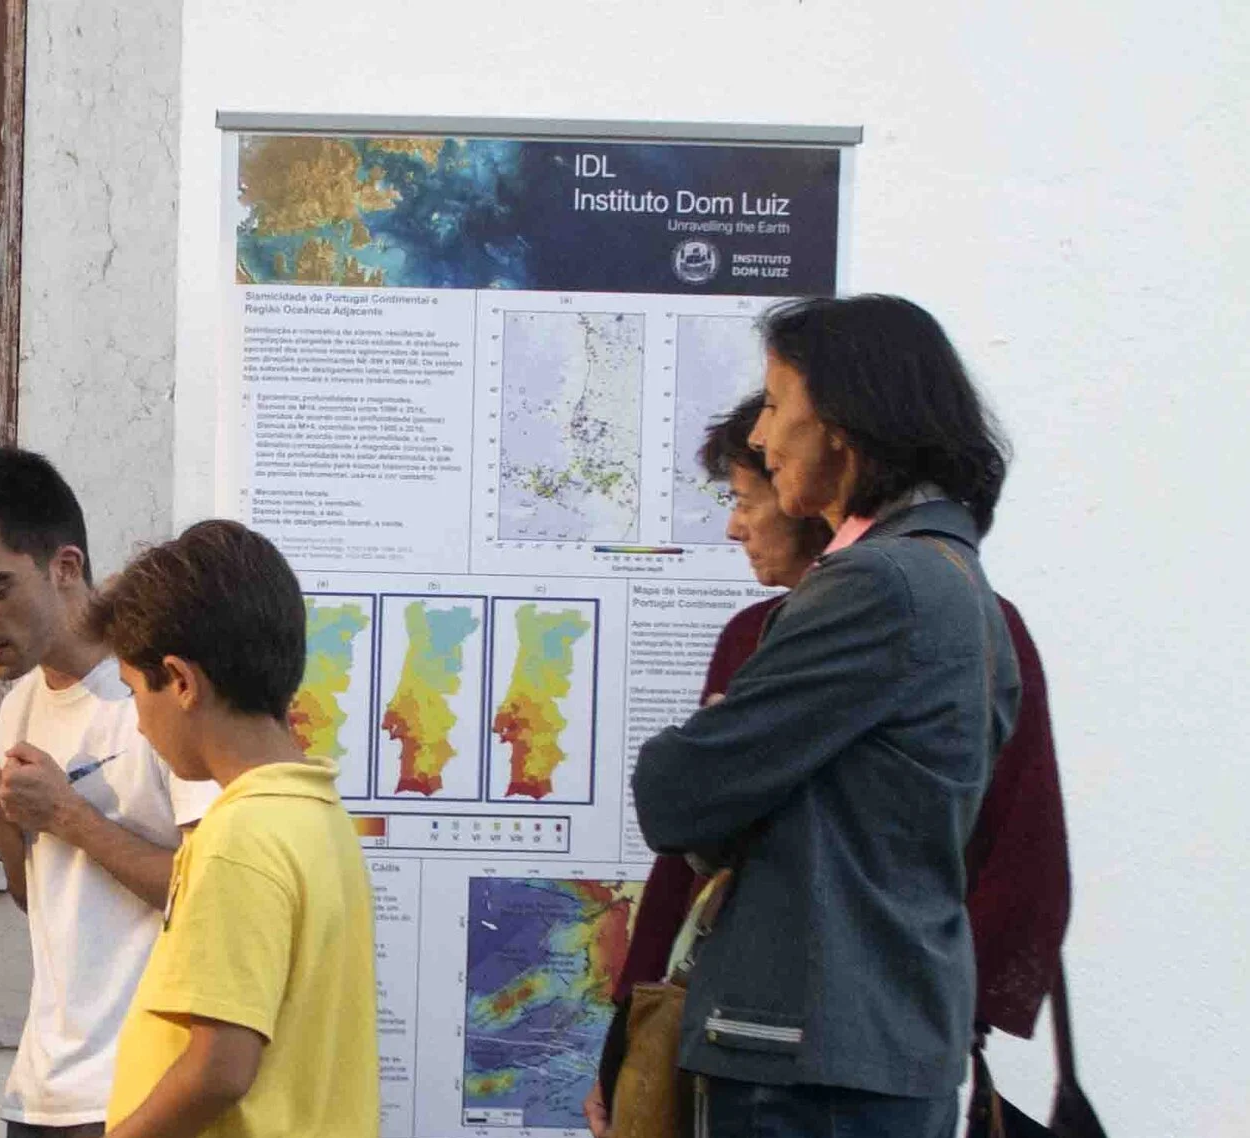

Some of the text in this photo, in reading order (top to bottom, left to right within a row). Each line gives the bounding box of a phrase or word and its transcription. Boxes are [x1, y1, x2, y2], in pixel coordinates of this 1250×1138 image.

[575, 154, 616, 178] IDL
[575, 187, 790, 216] Instituto Dom Luiz
[668, 219, 790, 235] Unravelling the Earth
[732, 253, 791, 265] INSTITUTO
[732, 266, 789, 278] DOM LUIZ
[245, 291, 306, 301] Sismicidade
[326, 293, 368, 304] Portugal
[371, 294, 431, 304] Continental
[245, 304, 382, 317] Região Oceânica Adjacente
[633, 585, 659, 596] Mapa
[677, 586, 742, 597] Intensidades
[632, 598, 736, 610] Portugal Continental
